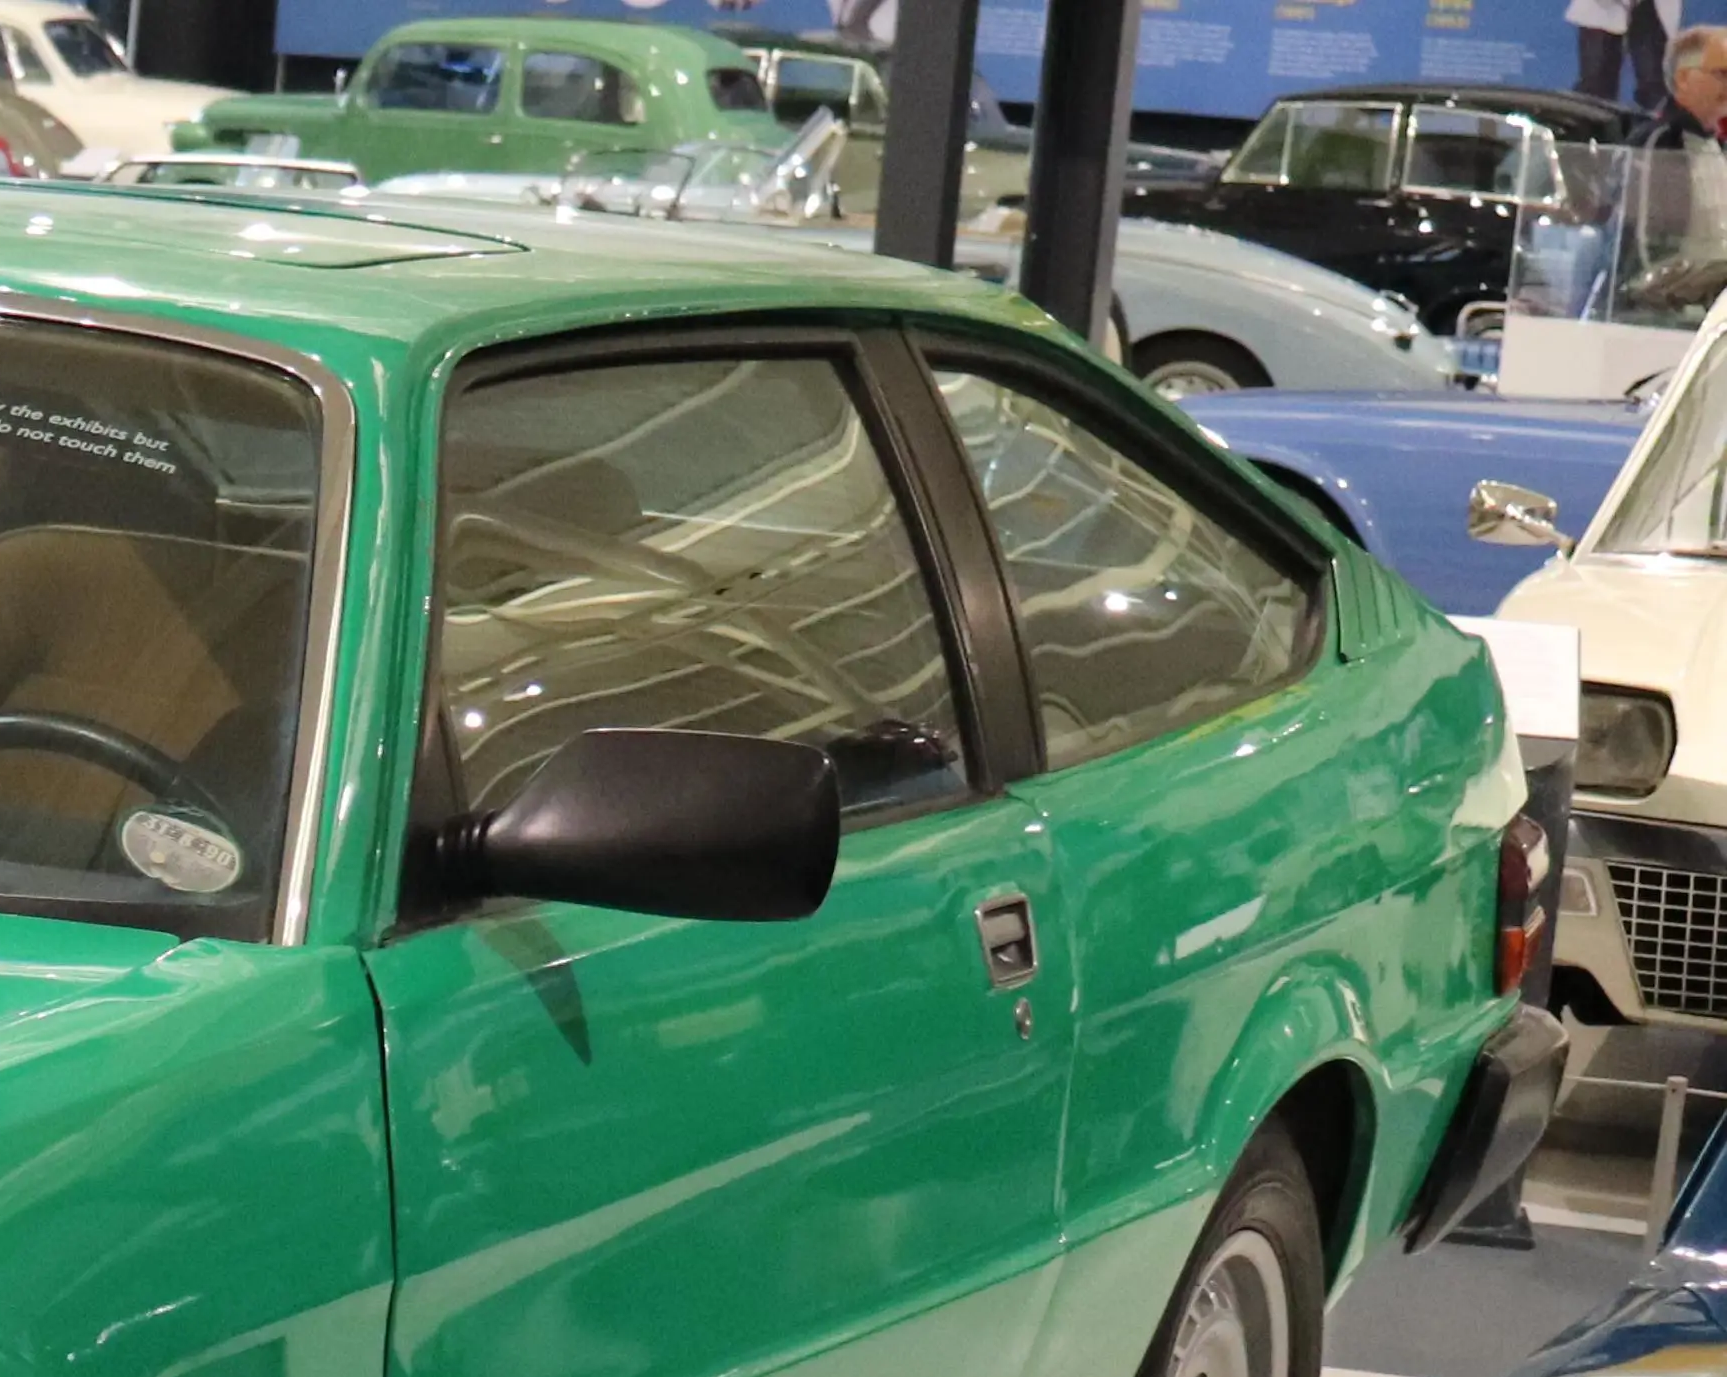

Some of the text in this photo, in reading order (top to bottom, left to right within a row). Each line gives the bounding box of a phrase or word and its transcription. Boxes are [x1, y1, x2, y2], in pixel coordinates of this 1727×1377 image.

[10, 404, 43, 421] the
[49, 414, 128, 441] exhibits
[133, 432, 170, 451] but
[17, 426, 54, 444] not
[58, 436, 118, 459] touch
[123, 452, 177, 474] them
